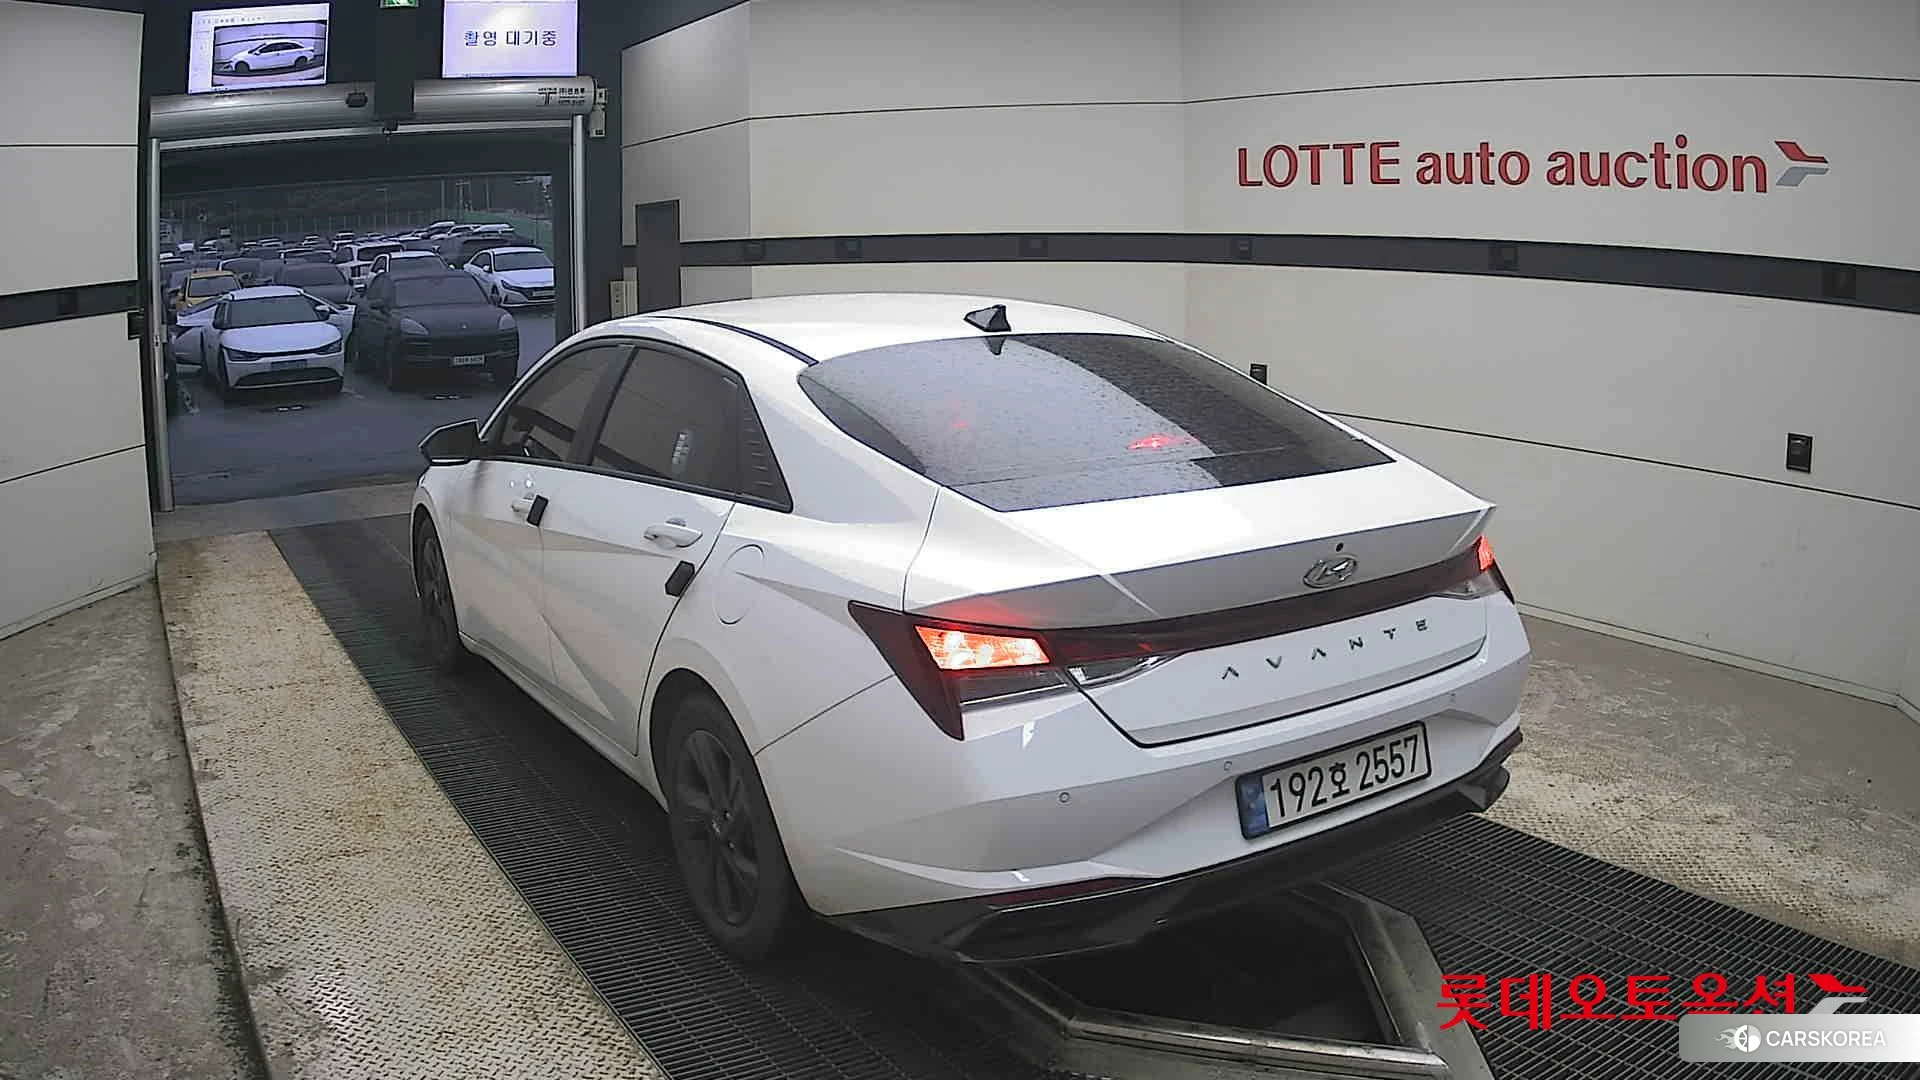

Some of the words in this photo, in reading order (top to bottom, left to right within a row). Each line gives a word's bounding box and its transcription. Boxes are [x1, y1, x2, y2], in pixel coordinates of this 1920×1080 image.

[464, 30, 497, 47] 촬영
[505, 30, 557, 47] 대기중
[1237, 141, 1401, 187] LOTTE
[1415, 141, 1531, 187] auto
[1545, 133, 1769, 194] auction
[1221, 618, 1429, 680] AVANTE
[1355, 734, 1418, 791] 2557
